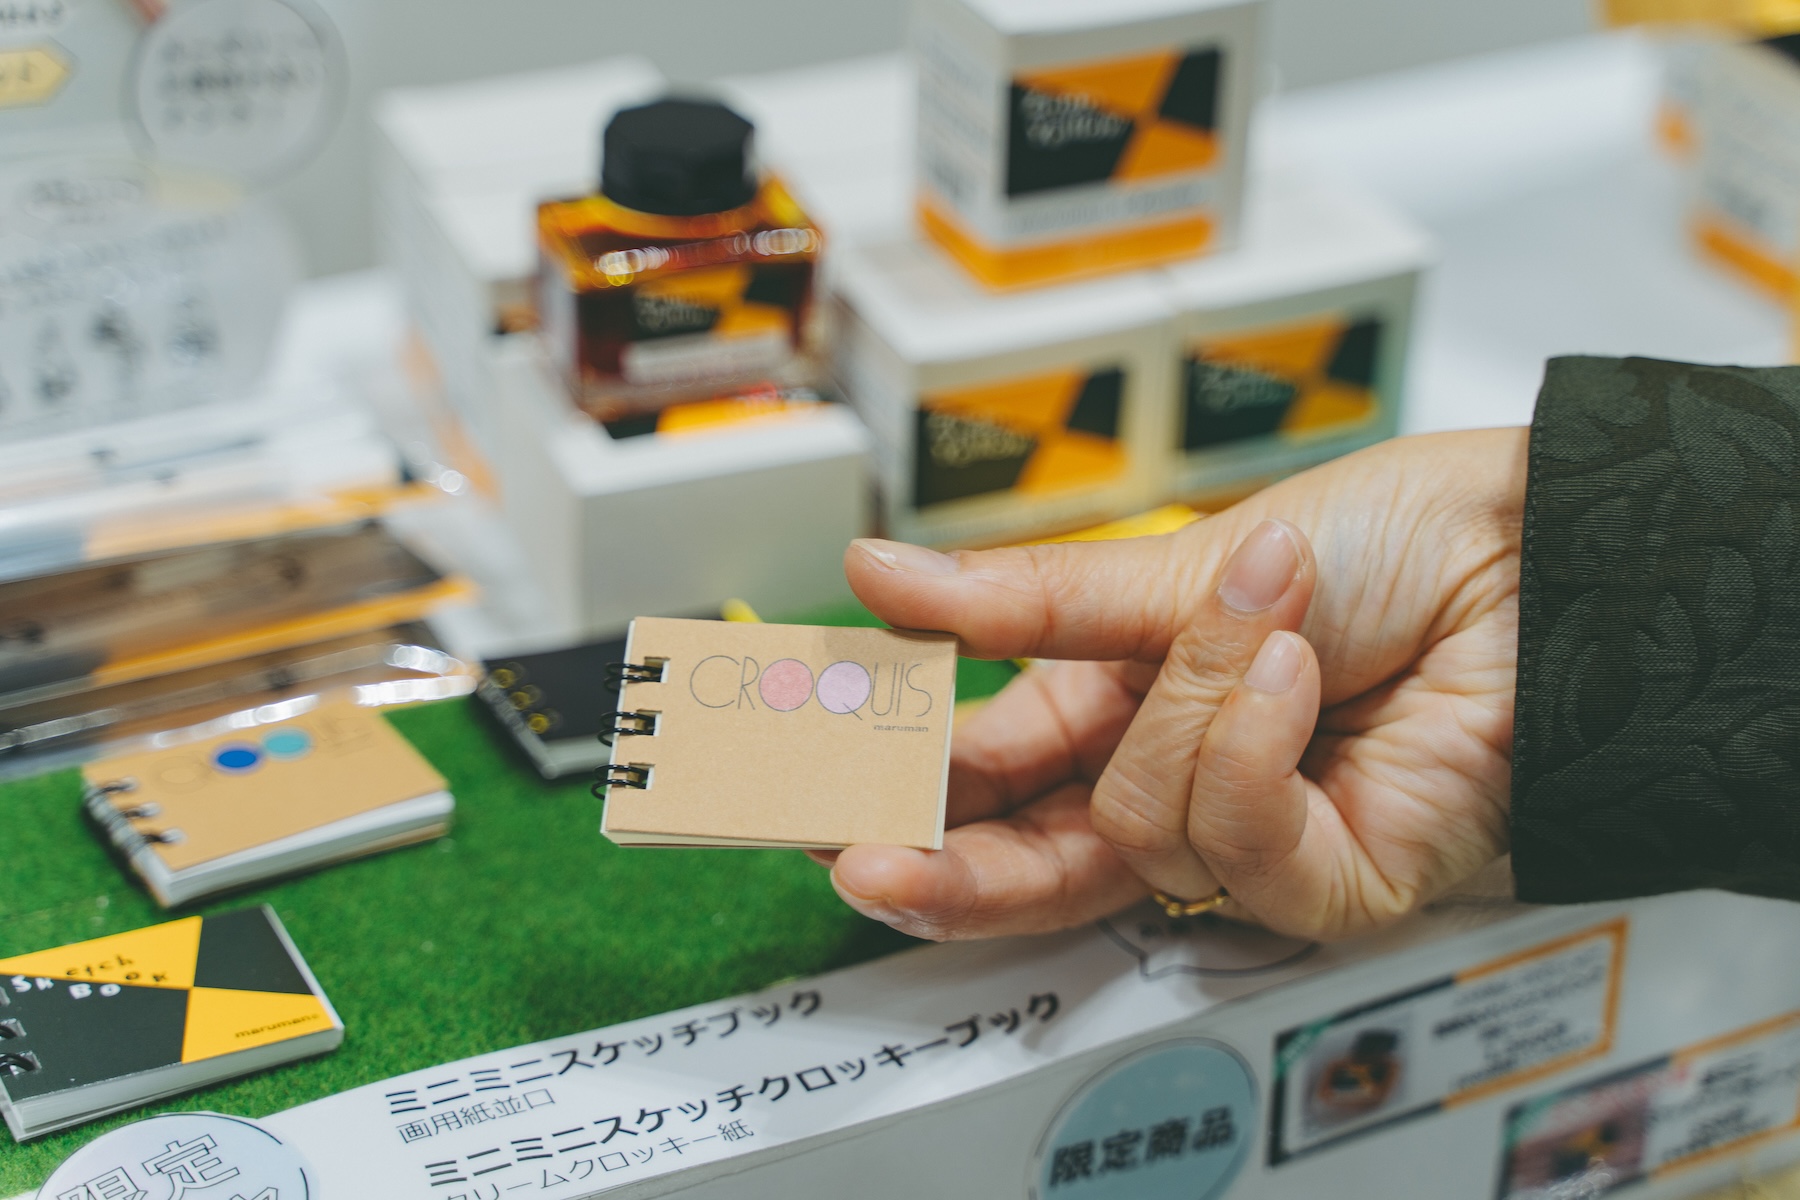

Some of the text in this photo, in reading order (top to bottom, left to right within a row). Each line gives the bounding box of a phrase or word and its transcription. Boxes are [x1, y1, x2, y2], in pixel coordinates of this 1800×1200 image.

[689, 654, 933, 721] CROQUIS
[873, 724, 929, 733] maruman
[385, 989, 823, 1115] ミニミニスケッチブック
[396, 1087, 556, 1144] 画用紙並口
[424, 990, 1060, 1187] ミニミニスケッチクロッキーブック
